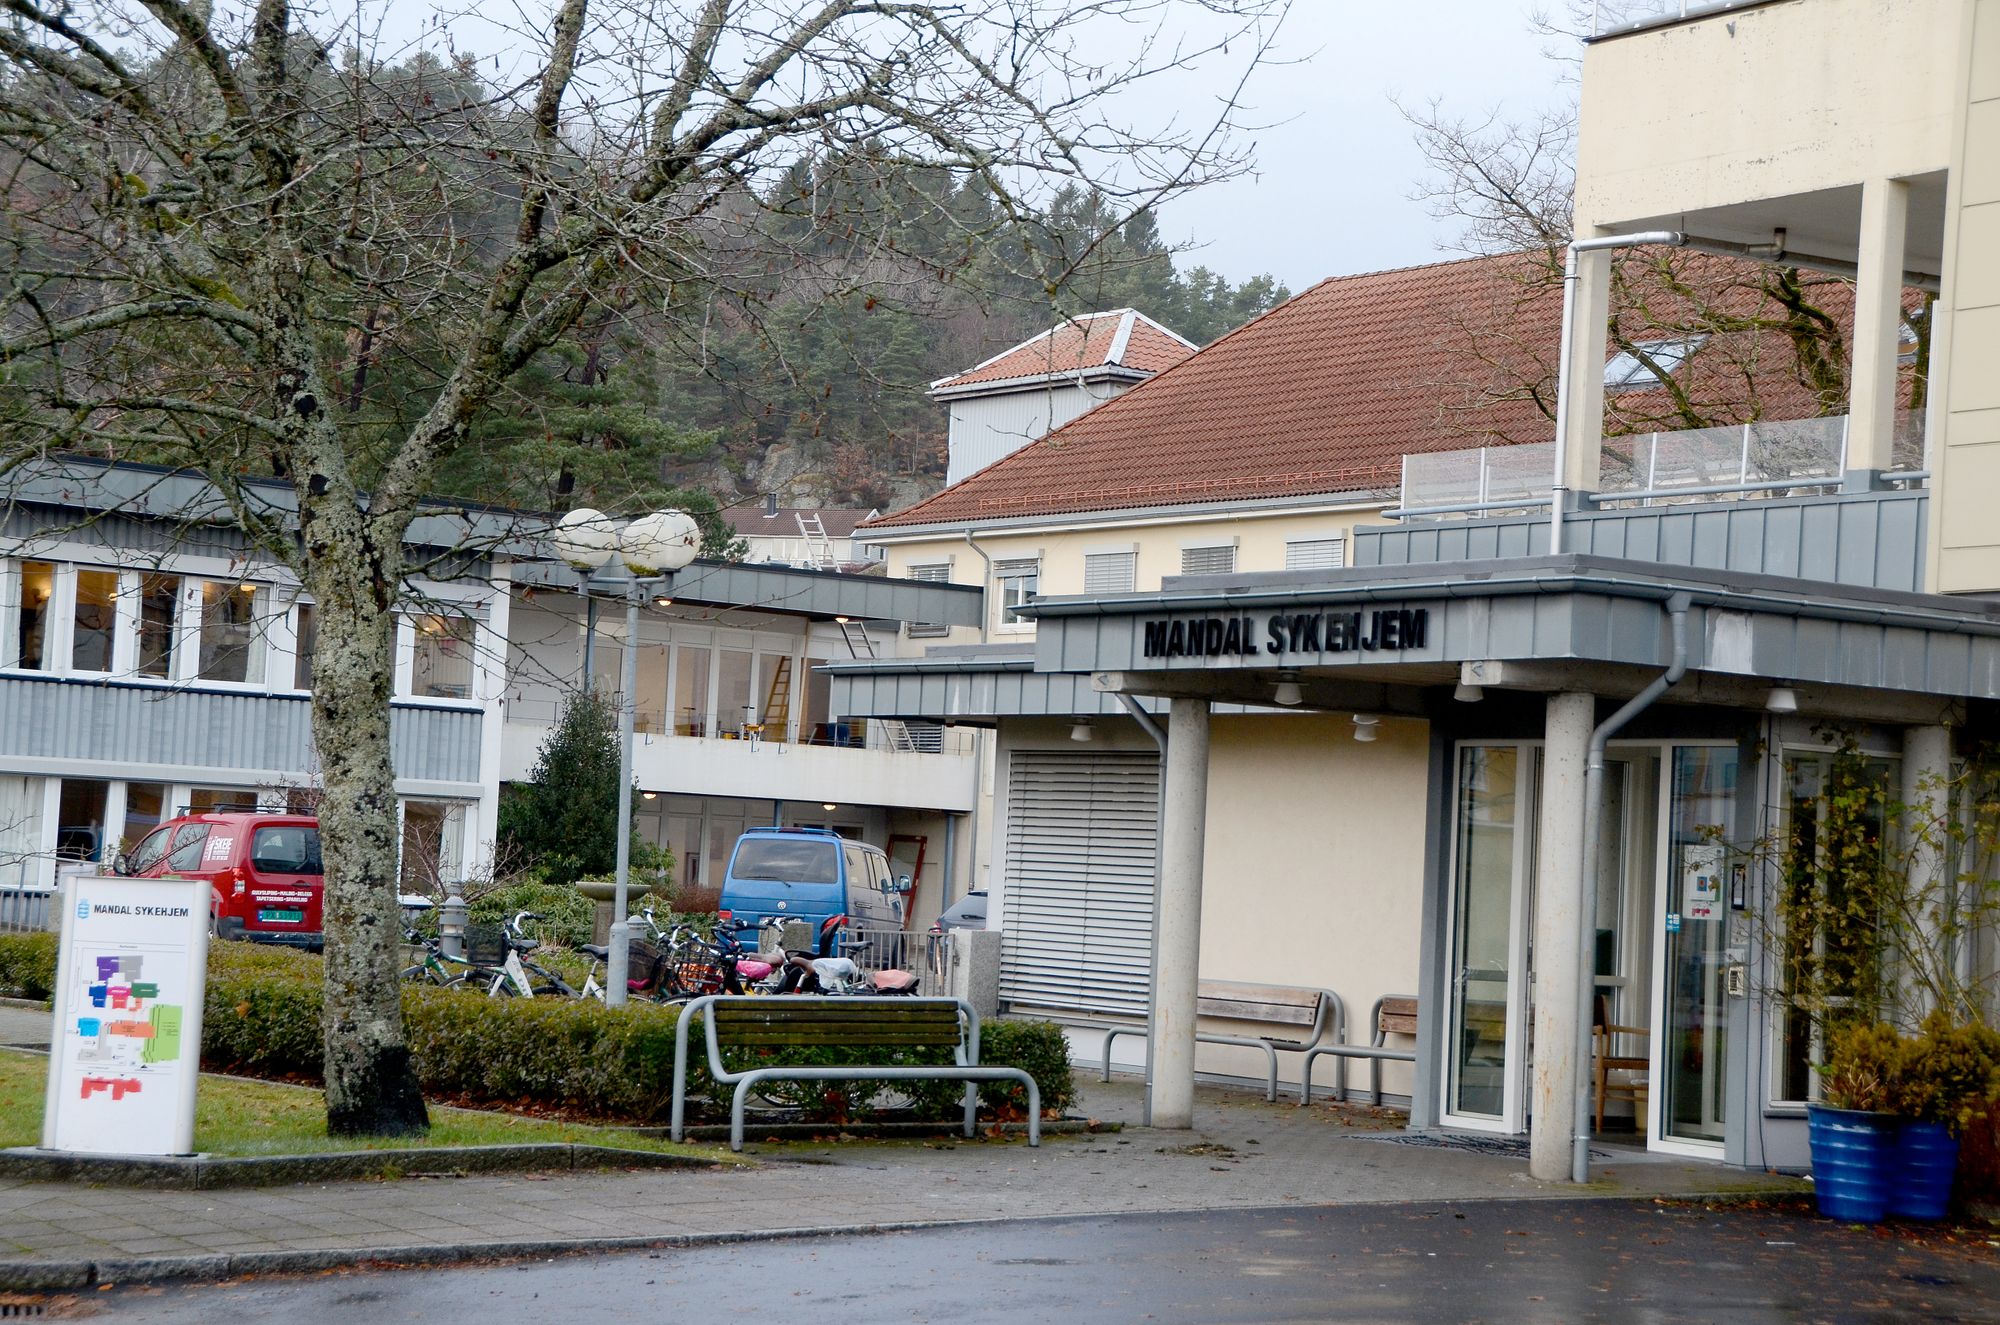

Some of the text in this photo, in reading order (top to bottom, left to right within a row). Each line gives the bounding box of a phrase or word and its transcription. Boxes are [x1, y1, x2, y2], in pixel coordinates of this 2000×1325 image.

[1144, 608, 1427, 658] MANDAL SYKEHJEM
[94, 904, 189, 917] MANDAL SYKEHJEM
